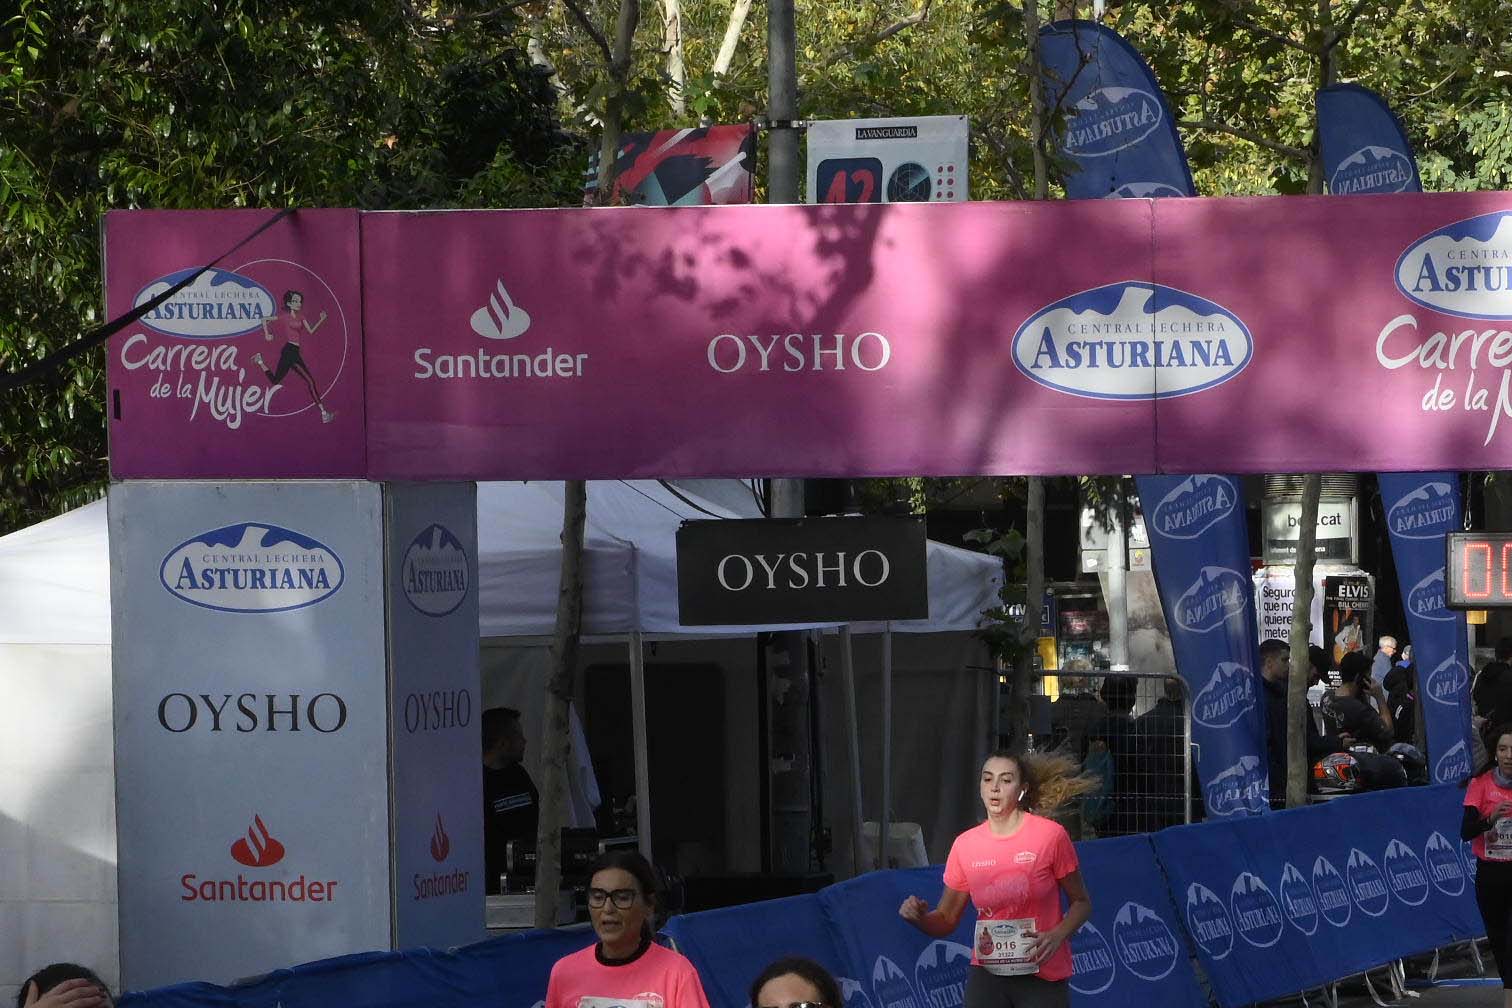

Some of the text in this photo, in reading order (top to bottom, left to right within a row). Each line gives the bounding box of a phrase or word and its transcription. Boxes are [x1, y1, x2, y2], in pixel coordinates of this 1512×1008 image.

[172, 291, 208, 299] ENTRAL
[1067, 321, 1226, 335] CENTRAL LECHERA
[121, 333, 238, 370] Carrera
[414, 347, 588, 379] Santander
[706, 332, 892, 374] OYSHO
[1030, 326, 1234, 370] ASTURIANA
[150, 367, 283, 429] de la Mujer
[1421, 372, 1455, 411] de
[1464, 370, 1489, 411] la
[174, 556, 332, 591] ASTURIANA
[202, 552, 325, 563] CENTRAL LECHERA
[717, 549, 892, 592] OYSHO
[407, 565, 465, 596] ASTURIANA
[1338, 585, 1369, 598] ELVIS
[1264, 602, 1280, 613] que
[157, 692, 348, 733] OYSHO
[403, 688, 472, 734] OYSHO
[181, 873, 338, 902] Santander
[413, 868, 471, 901] Santander
[995, 941, 1017, 951] 016
